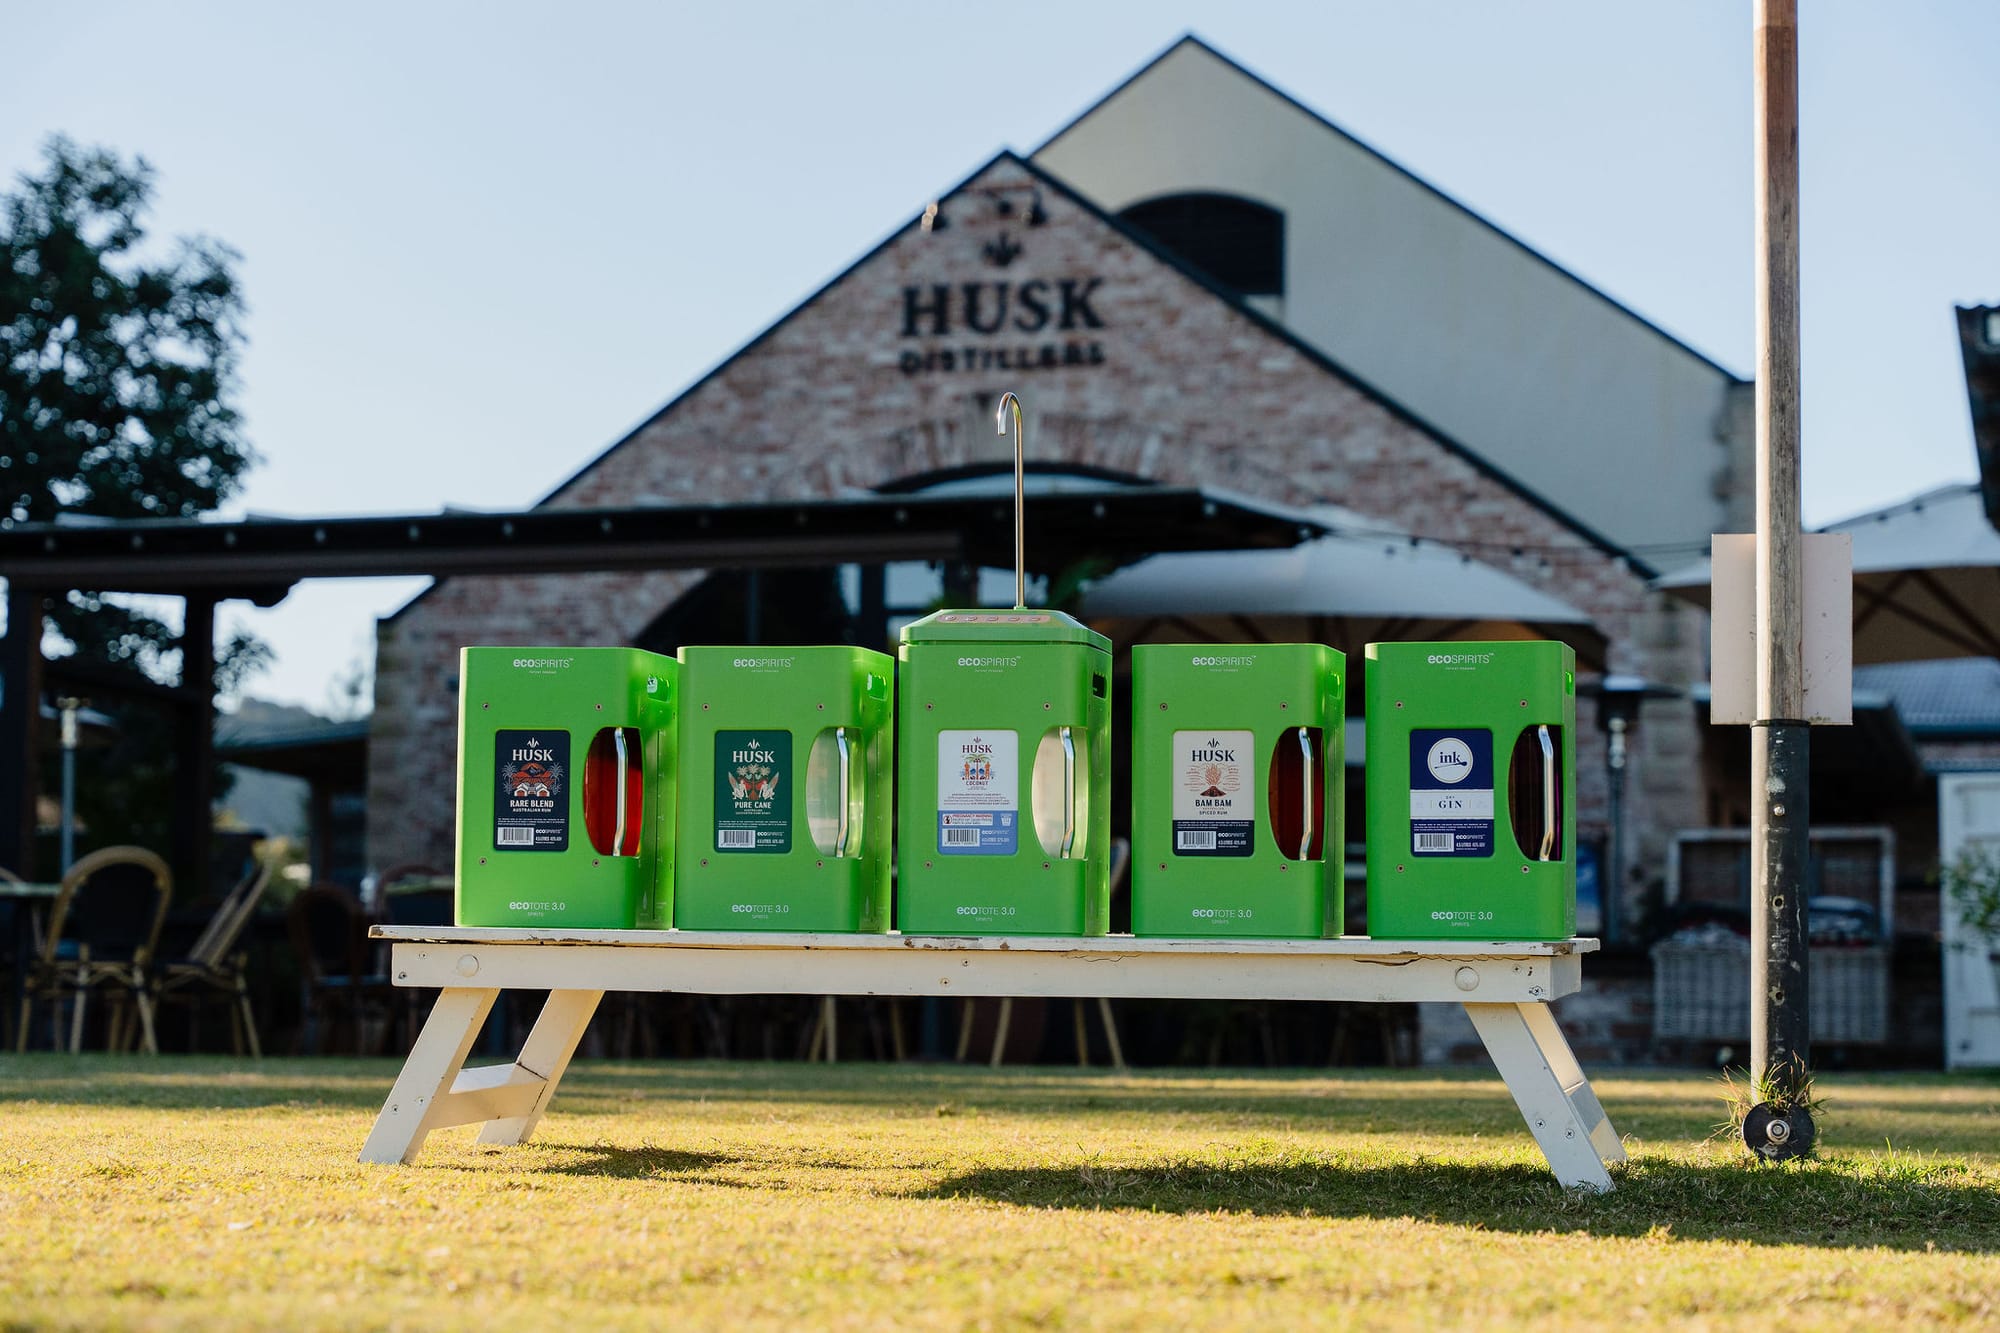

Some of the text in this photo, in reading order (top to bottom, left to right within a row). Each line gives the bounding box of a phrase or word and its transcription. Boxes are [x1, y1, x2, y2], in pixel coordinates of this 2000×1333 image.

[902, 276, 1105, 336] HUSK
[962, 744, 993, 754] HUSK
[512, 749, 553, 761] HUSK
[732, 750, 775, 763] HUSK
[1192, 750, 1235, 762] HUSK
[1440, 752, 1461, 764] ink
[510, 800, 554, 808] RARE BLEND
[1438, 800, 1462, 808] GIN
[552, 902, 566, 910] 3.0
[776, 905, 789, 913] 3.0
[1001, 907, 1016, 915] 3.0
[1238, 910, 1252, 918] 3.0
[1478, 912, 1493, 920] 3.0
